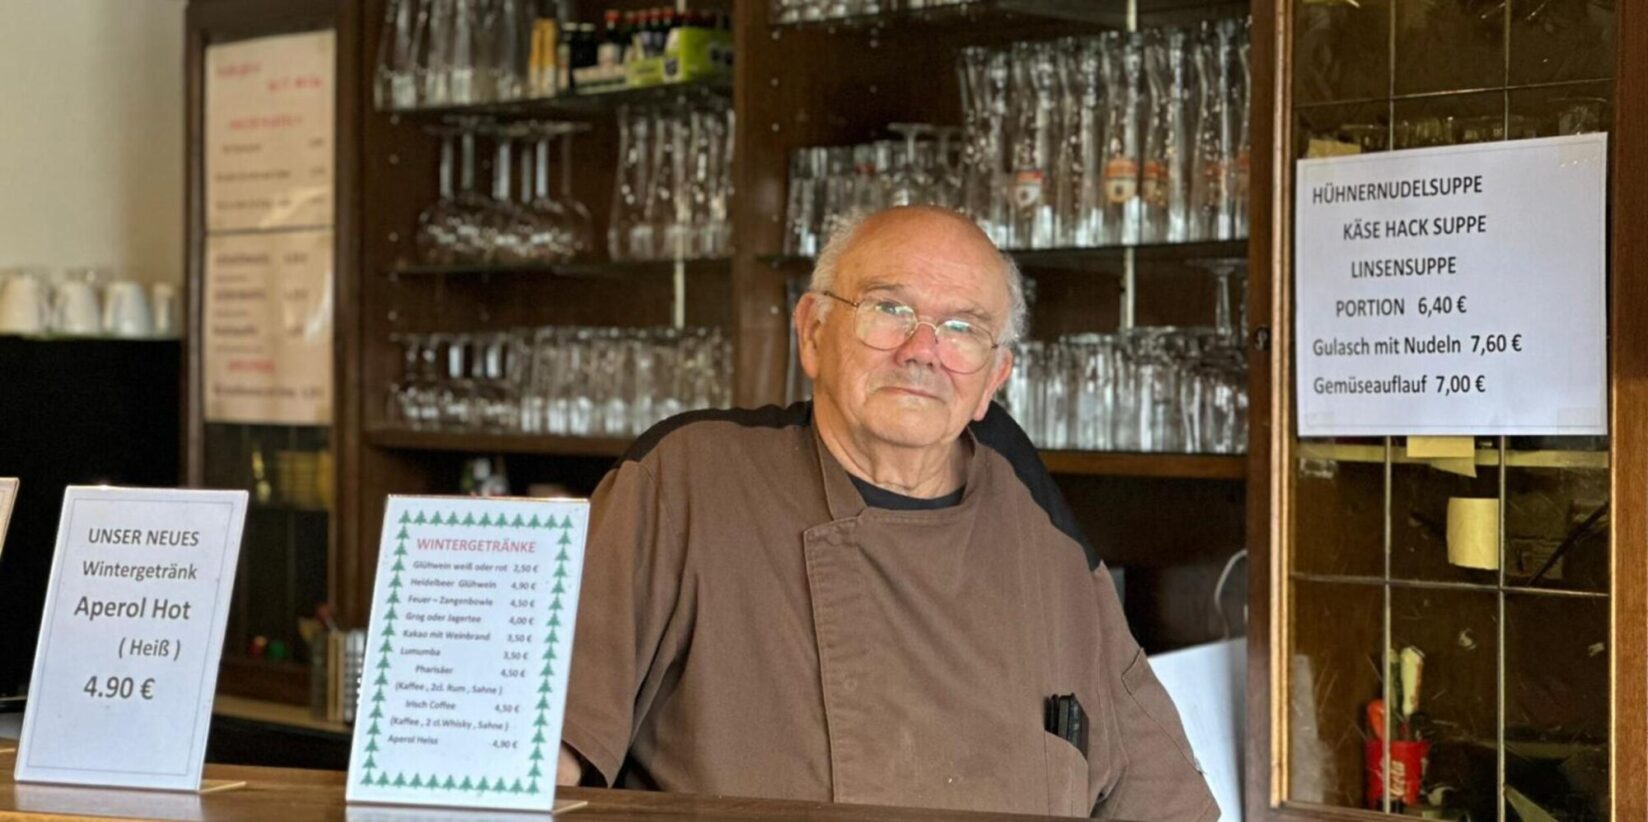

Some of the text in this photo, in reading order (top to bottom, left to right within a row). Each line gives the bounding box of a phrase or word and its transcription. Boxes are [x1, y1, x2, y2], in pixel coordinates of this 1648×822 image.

[1312, 175, 1483, 204] HÜHNERNUDELSUPPE
[1343, 215, 1487, 240] KÄSE HACK SUPPE
[1351, 256, 1457, 278] LINSENSUPPE
[1336, 295, 1467, 317] PORTION 6,40 €
[1312, 333, 1522, 356] Gulasch mit Nudeln 7,60 €
[1313, 374, 1486, 396] Gemüseauflauf 7,00 €
[88, 528, 200, 547] UNSER NEUES
[416, 538, 536, 553] WINTERGETRÄNKE
[82, 561, 197, 581] Wintergetränk
[413, 561, 451, 570] Glühwein
[453, 562, 473, 571] weiß
[475, 563, 493, 571] oder
[495, 564, 508, 572] rot
[410, 578, 454, 587] Heidelbeer
[458, 580, 497, 589] Glühwein
[511, 581, 529, 590] 4,90
[408, 595, 431, 603] Feuer
[440, 596, 493, 607] Zangenbowle
[74, 596, 191, 621] Aperol Hot
[405, 612, 425, 622] Grog
[427, 613, 445, 621] oder
[403, 630, 428, 639] Kakao
[430, 630, 443, 639] mit
[445, 631, 491, 641] Weinbrand
[400, 647, 441, 656] Lumumba
[415, 665, 453, 674] Pharisäer
[84, 675, 155, 700] 4.90 €
[447, 684, 466, 692] Rum
[472, 685, 497, 694] Sahne
[405, 700, 428, 709] Irisch
[429, 701, 456, 710] Coffee
[478, 721, 503, 730] Sahne
[387, 735, 415, 745] Aperol
